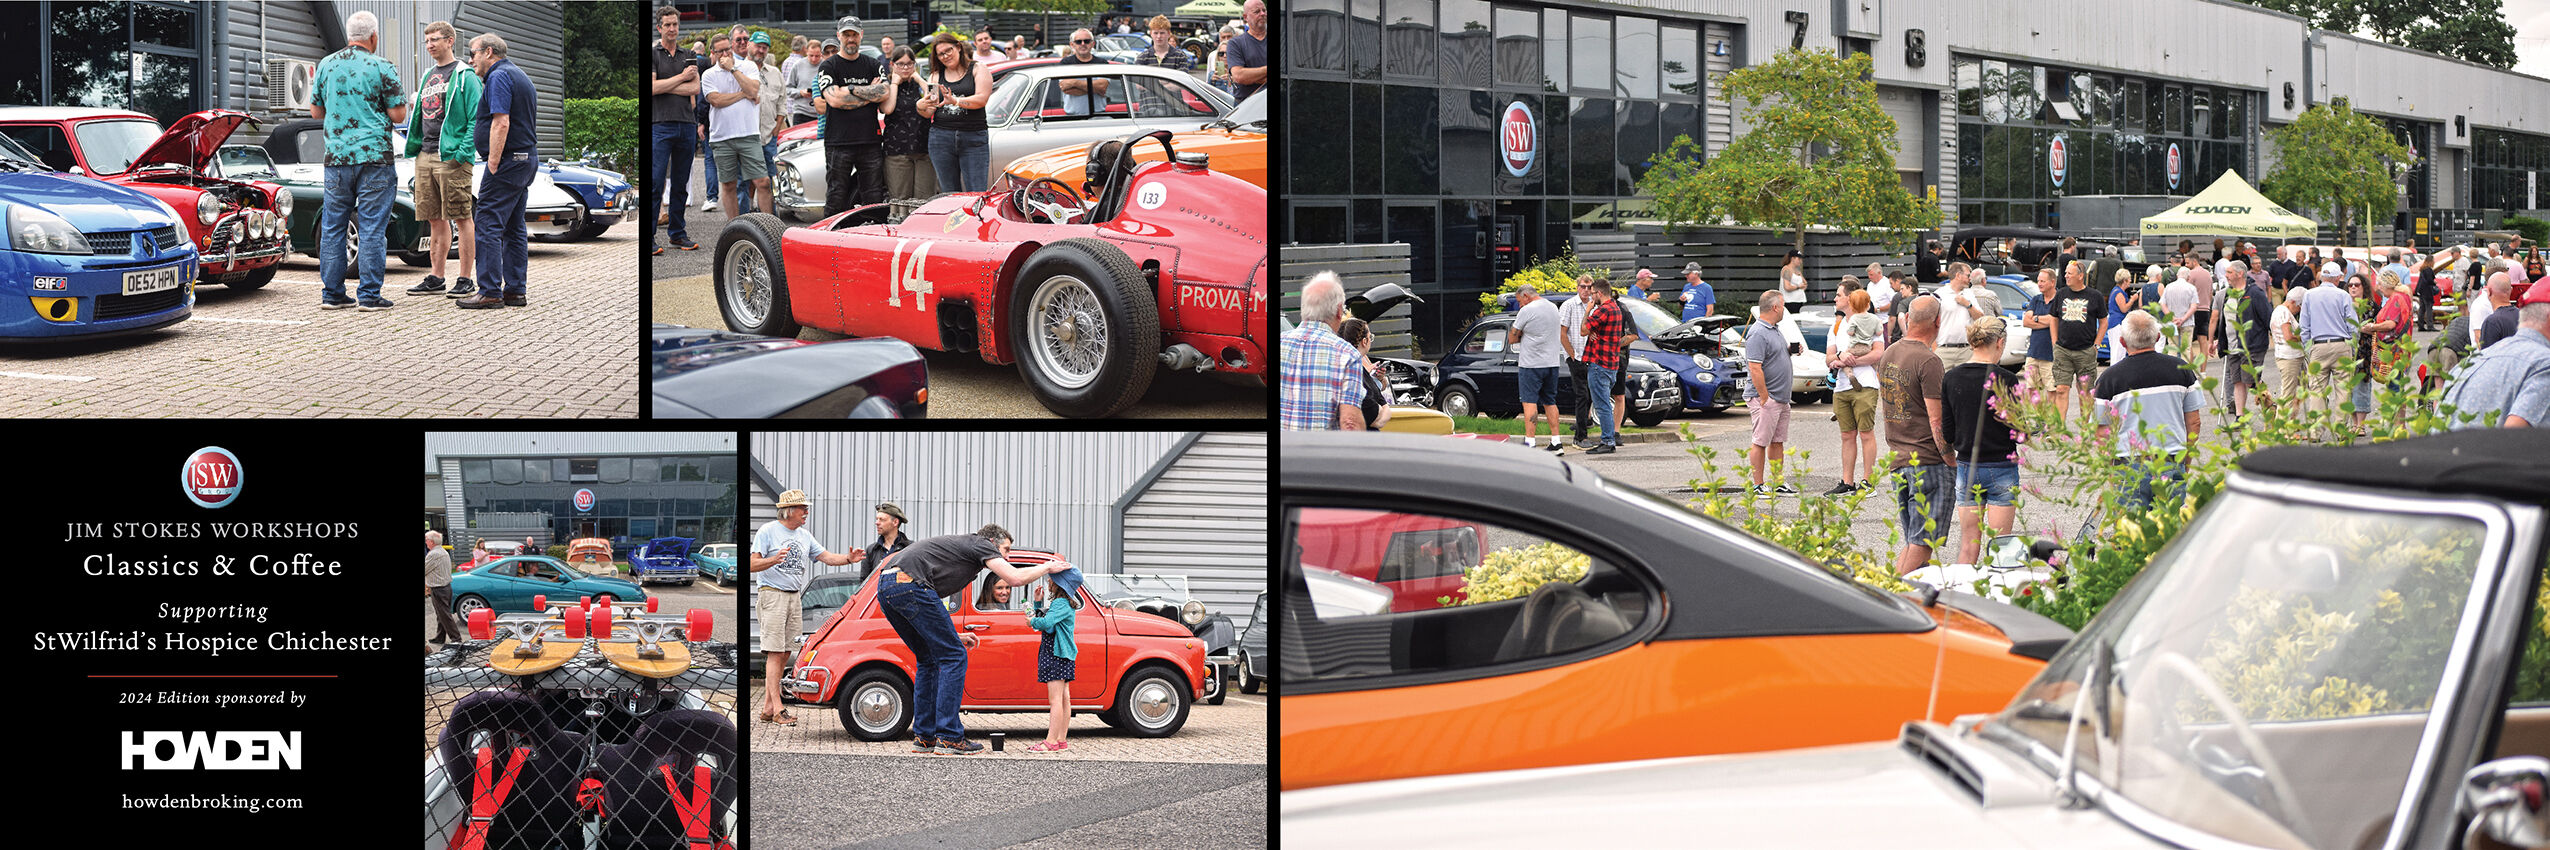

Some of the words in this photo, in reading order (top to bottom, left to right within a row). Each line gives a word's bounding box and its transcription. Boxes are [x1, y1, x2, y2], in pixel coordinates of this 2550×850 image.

[1785, 11, 1809, 52] 7
[1905, 28, 1926, 67] 8
[1505, 121, 1530, 156] JSW
[1142, 192, 1160, 205] 133
[2185, 205, 2251, 214] HOWDEN
[35, 277, 56, 289] elf
[127, 272, 156, 292] OE52
[157, 269, 176, 289] HPN
[889, 239, 935, 312] 14
